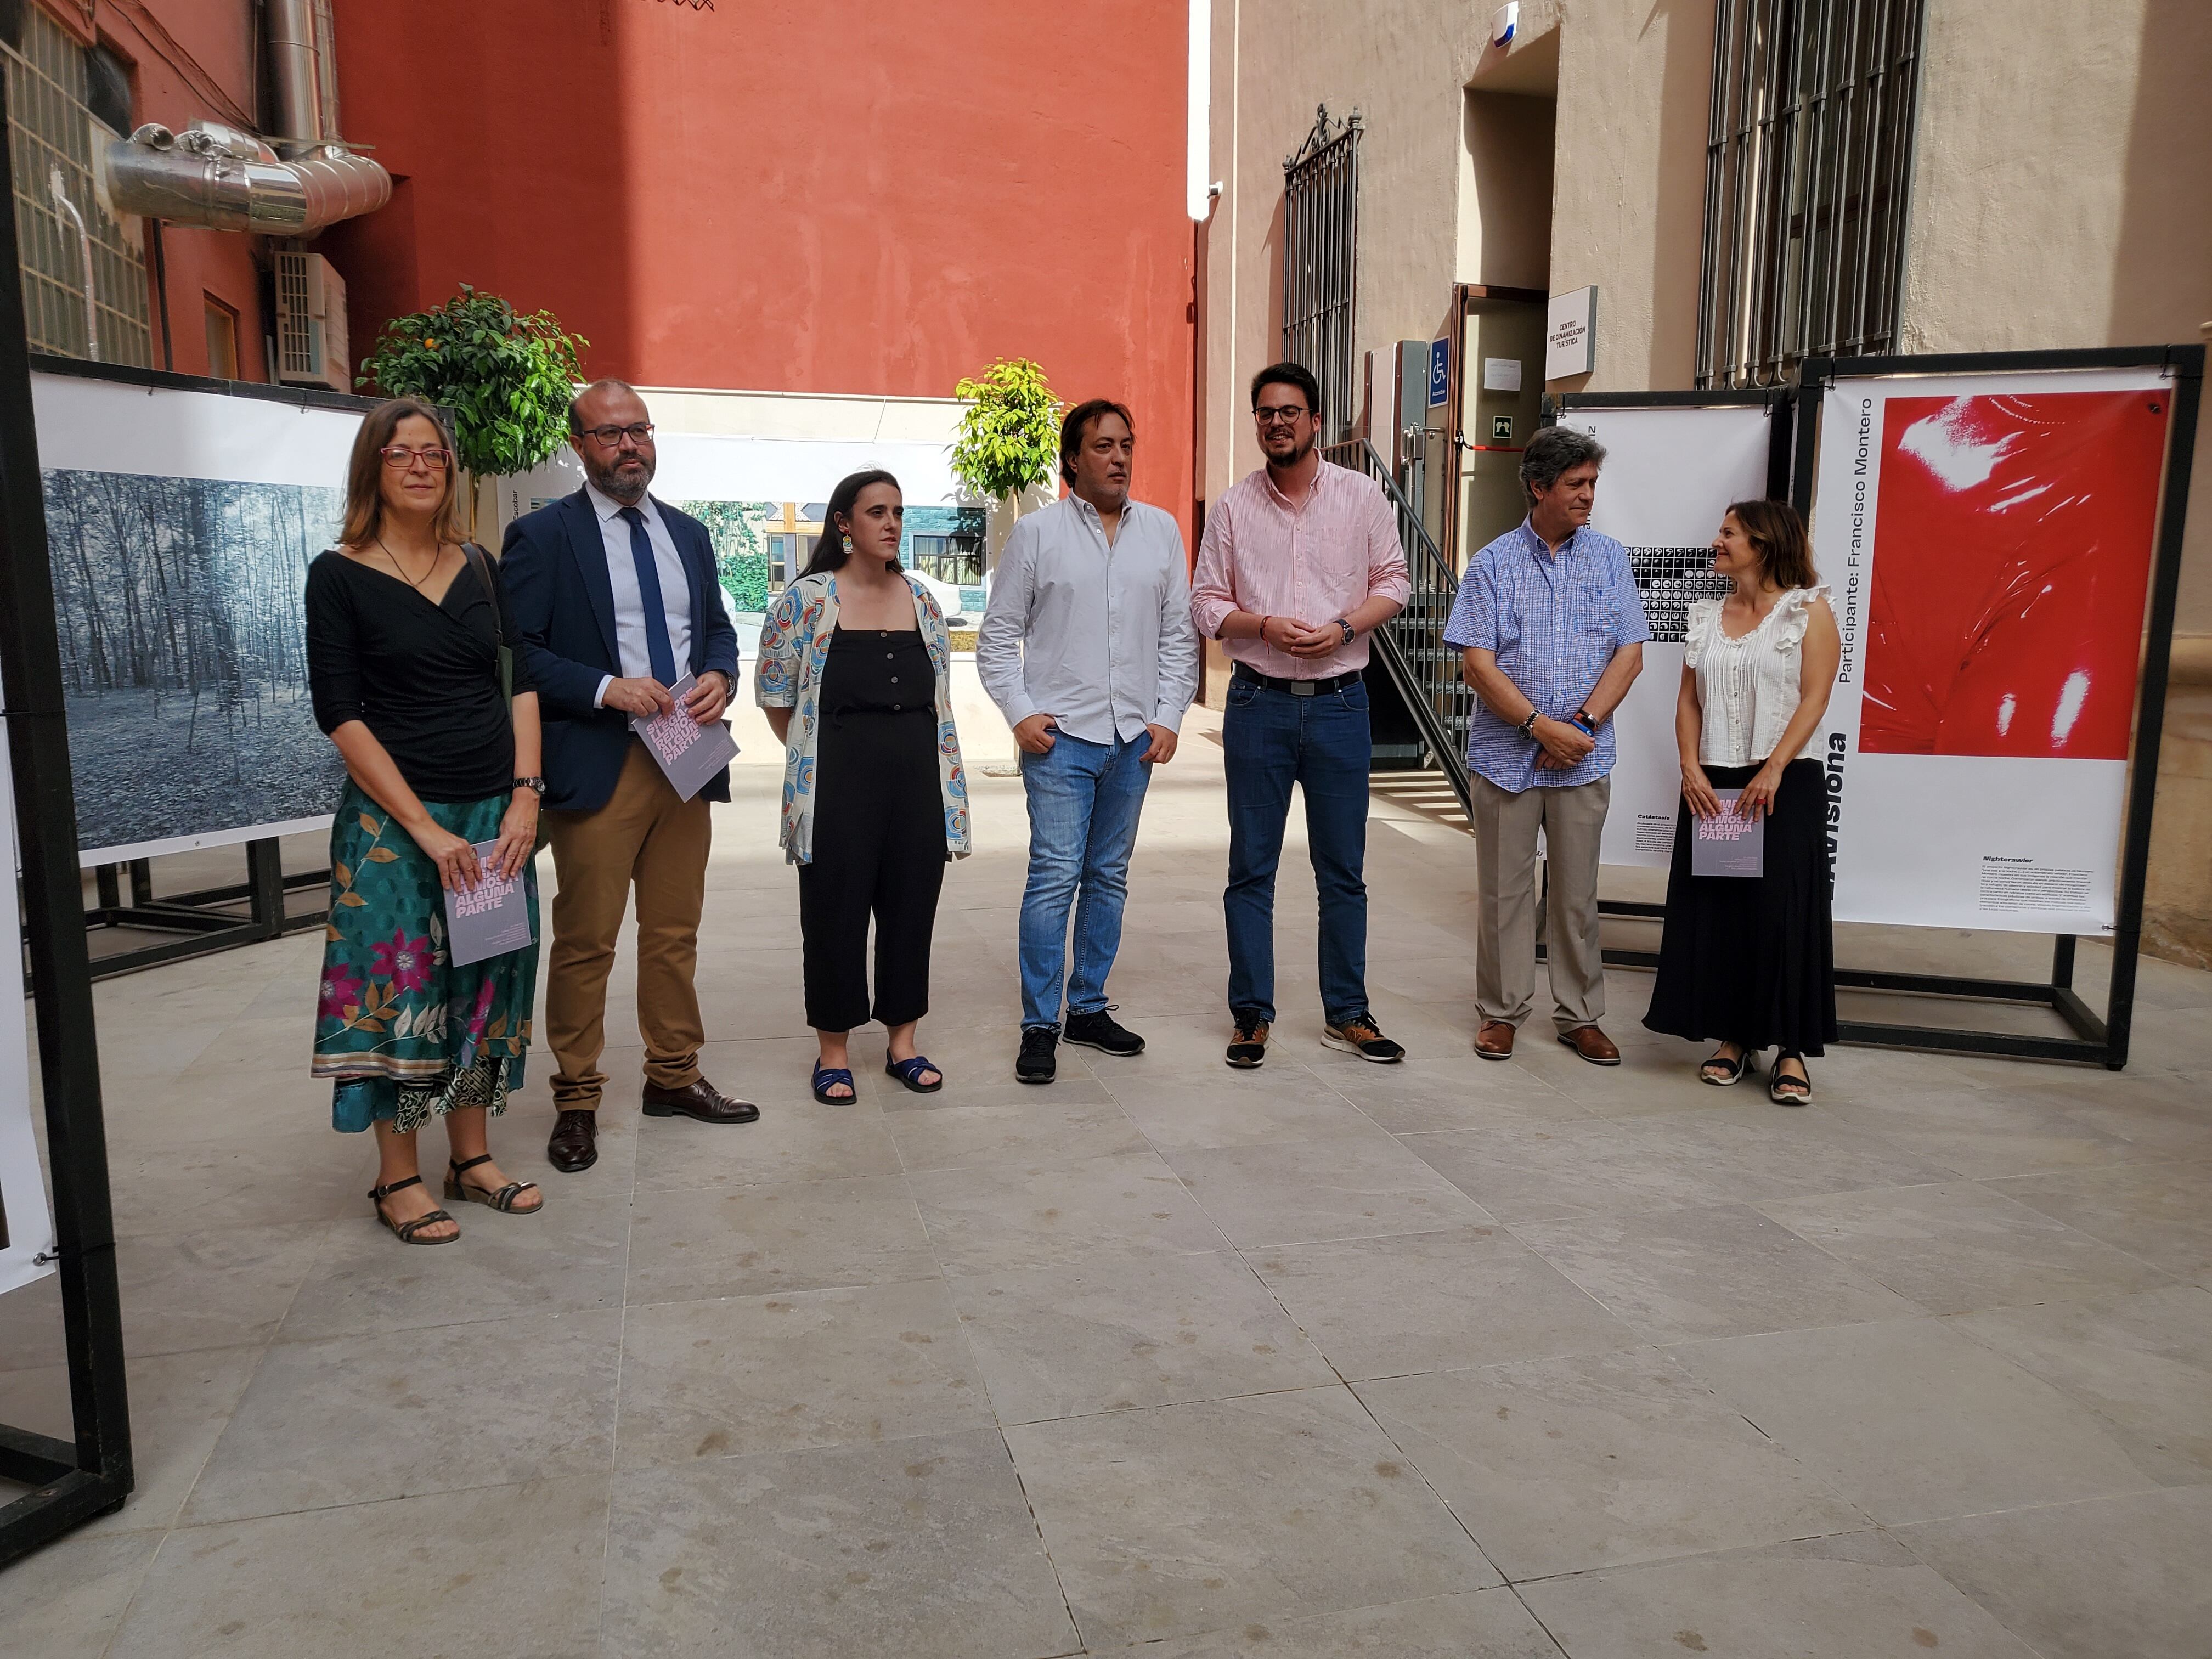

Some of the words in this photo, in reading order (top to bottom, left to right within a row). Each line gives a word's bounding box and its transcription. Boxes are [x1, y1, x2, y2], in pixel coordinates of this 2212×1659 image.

[1556, 325, 1585, 340] DINAMIZACIÓN
[1560, 320, 1576, 331] CENTRO
[1557, 338, 1578, 348] TURÍSTICA
[1854, 398, 1872, 475] Montero
[1848, 481, 1865, 567] Francisco
[1839, 573, 1859, 683] Participante:
[662, 720, 699, 759] ALGUN
[665, 729, 701, 766] PARTE
[1699, 824, 1752, 832] ALGUNA
[1699, 832, 1740, 840] PARTE
[455, 883, 515, 908] ALGUNA
[456, 896, 503, 918] PARTE
